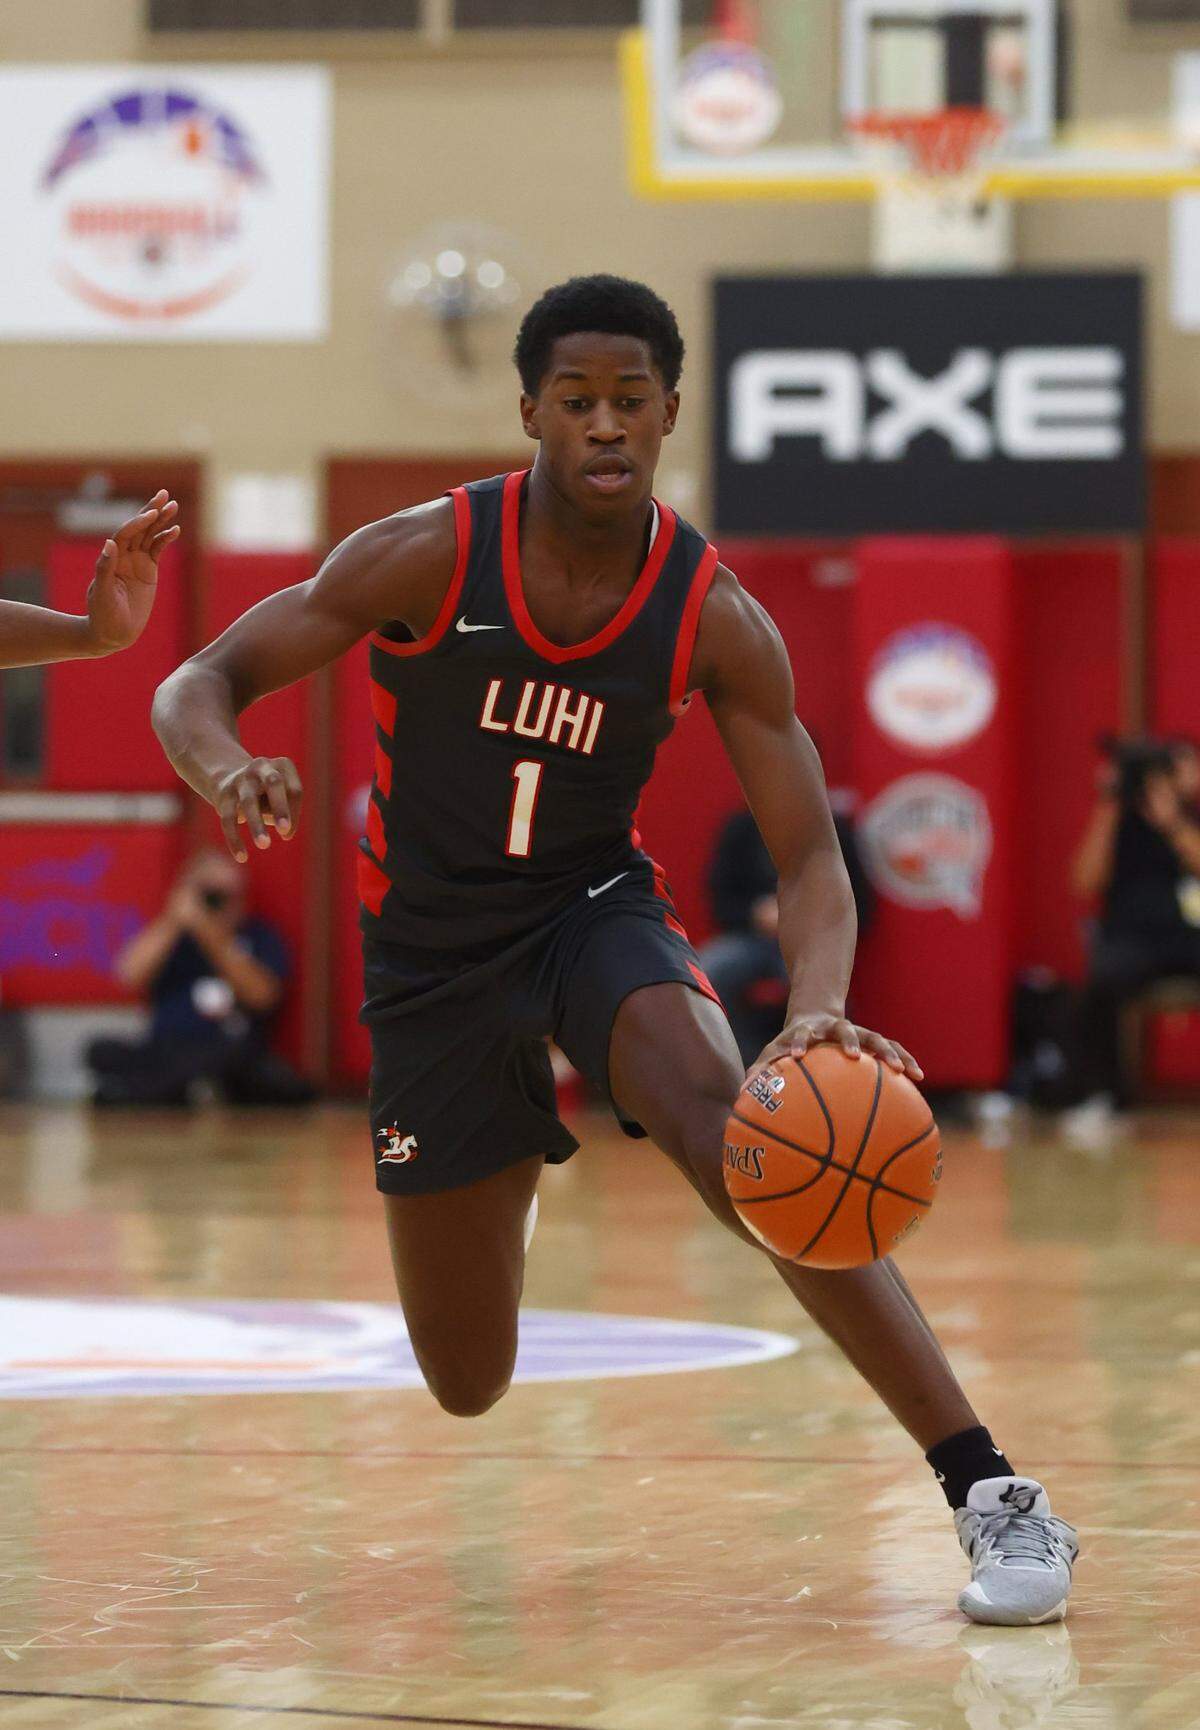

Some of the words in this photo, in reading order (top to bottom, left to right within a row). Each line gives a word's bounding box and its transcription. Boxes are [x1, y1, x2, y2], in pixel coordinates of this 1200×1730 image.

[729, 346, 1124, 461] AXE
[478, 679, 606, 756] LUHI
[506, 759, 544, 858] 1
